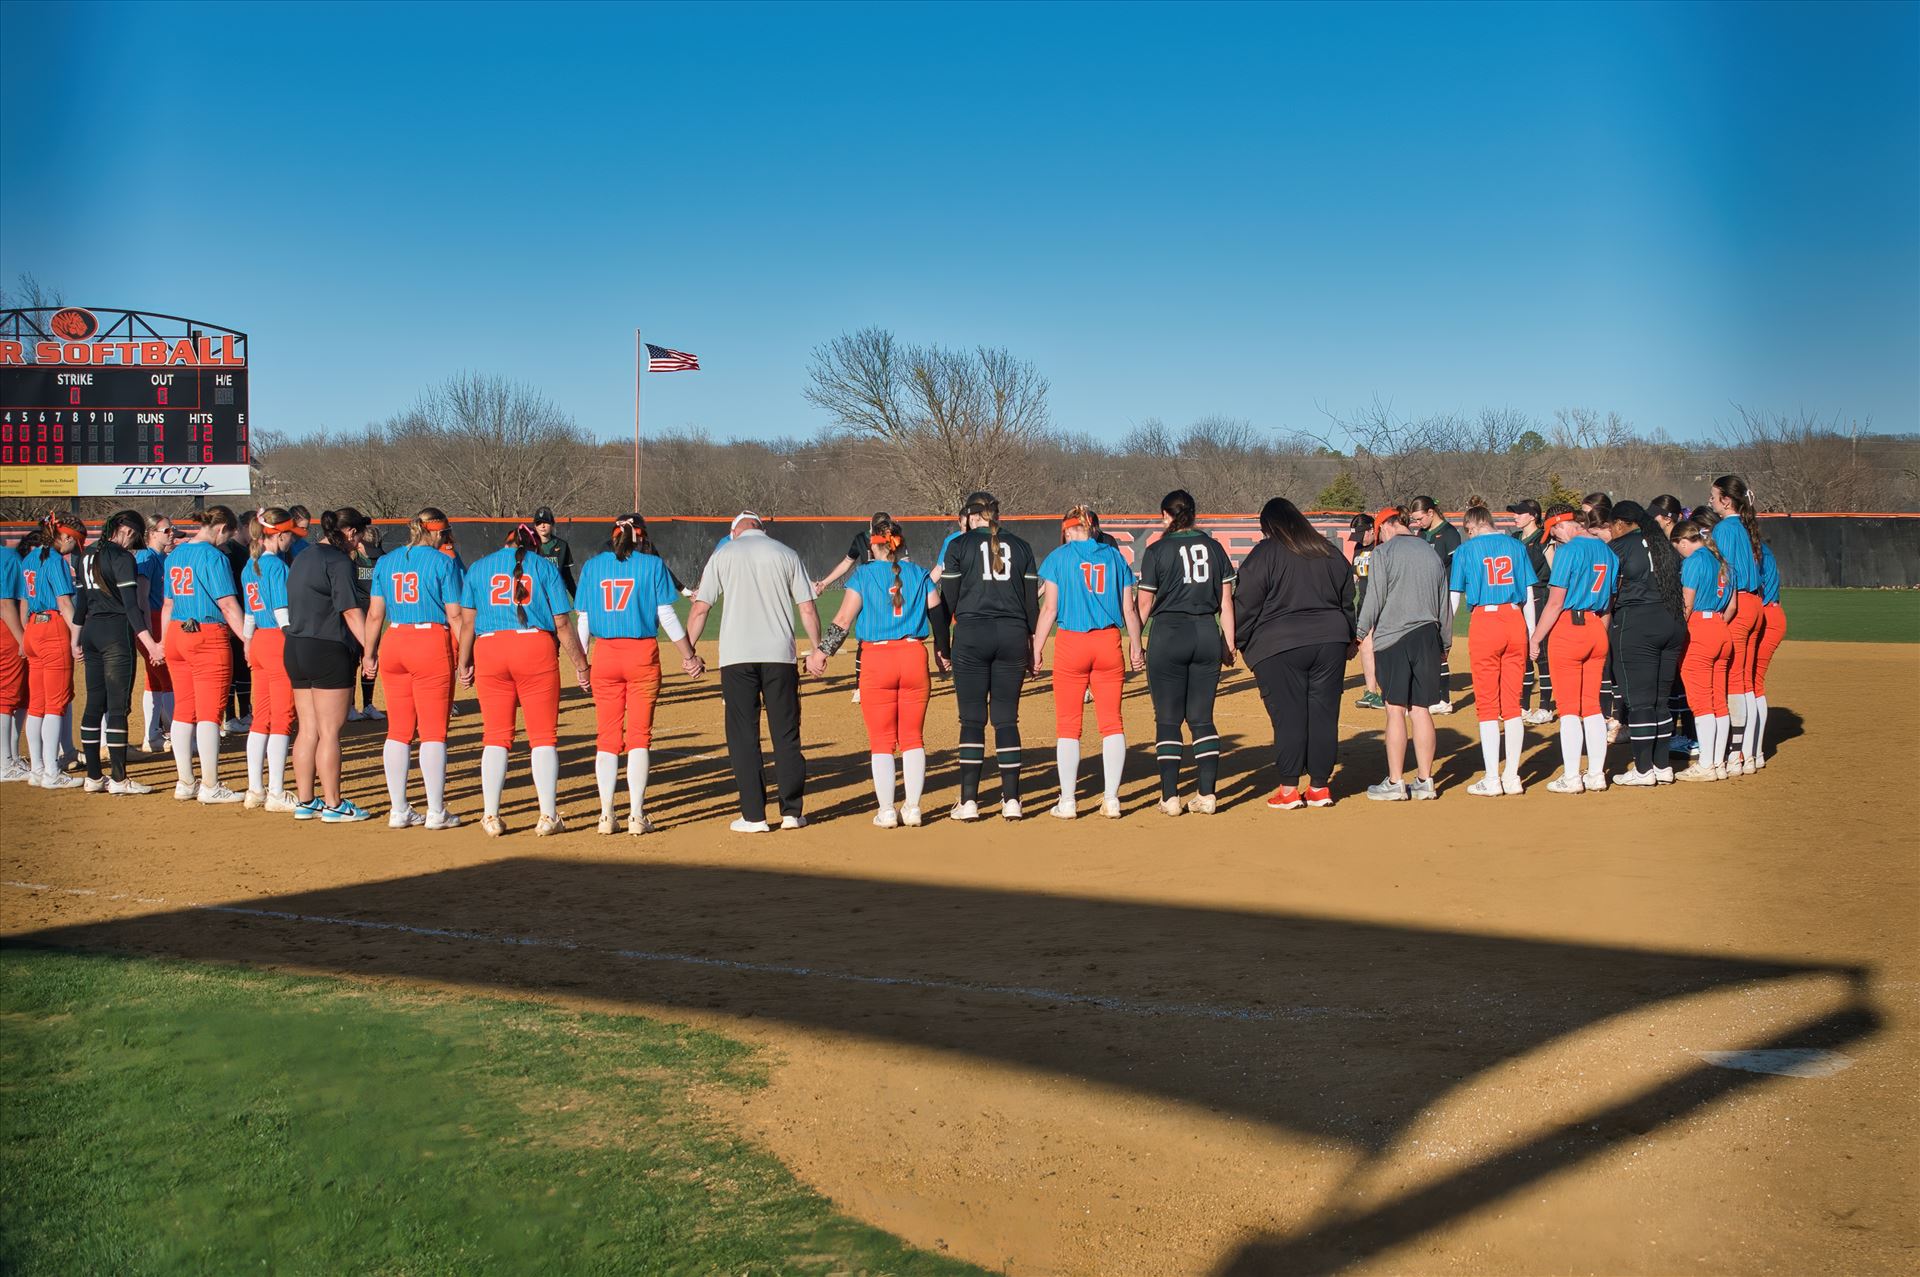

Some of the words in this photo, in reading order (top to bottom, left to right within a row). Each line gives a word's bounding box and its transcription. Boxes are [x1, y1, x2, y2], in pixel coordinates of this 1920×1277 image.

[36, 334, 245, 366] SOFTBALL
[57, 373, 94, 386] STRIKE
[151, 373, 174, 386] OUT
[215, 374, 232, 386] H/E
[70, 386, 80, 405] 0
[157, 387, 168, 405] 0
[4, 412, 11, 422] 4
[22, 412, 28, 422] 5
[39, 412, 45, 422] 6
[55, 412, 61, 422] 7
[72, 412, 79, 422] 8
[90, 412, 96, 422] 9
[103, 412, 114, 422] 10
[137, 413, 165, 424] RUNS
[189, 413, 213, 424] HITS
[238, 413, 244, 424] E
[2, 424, 13, 442] 0
[20, 424, 30, 442] 0
[37, 424, 47, 442] 3
[53, 424, 63, 442] 0
[2, 445, 13, 463] 0
[20, 445, 30, 463] 0
[37, 445, 47, 463] 0
[54, 445, 64, 463] 3
[153, 445, 164, 463] 5
[203, 445, 213, 463] 6
[122, 466, 207, 485] TFCU
[1179, 544, 1209, 584] 18
[1483, 556, 1515, 586] 12
[170, 567, 195, 596] 22
[1080, 562, 1106, 594] 11
[1591, 564, 1608, 594] 7
[392, 571, 419, 604] 13
[600, 578, 635, 612] 17
